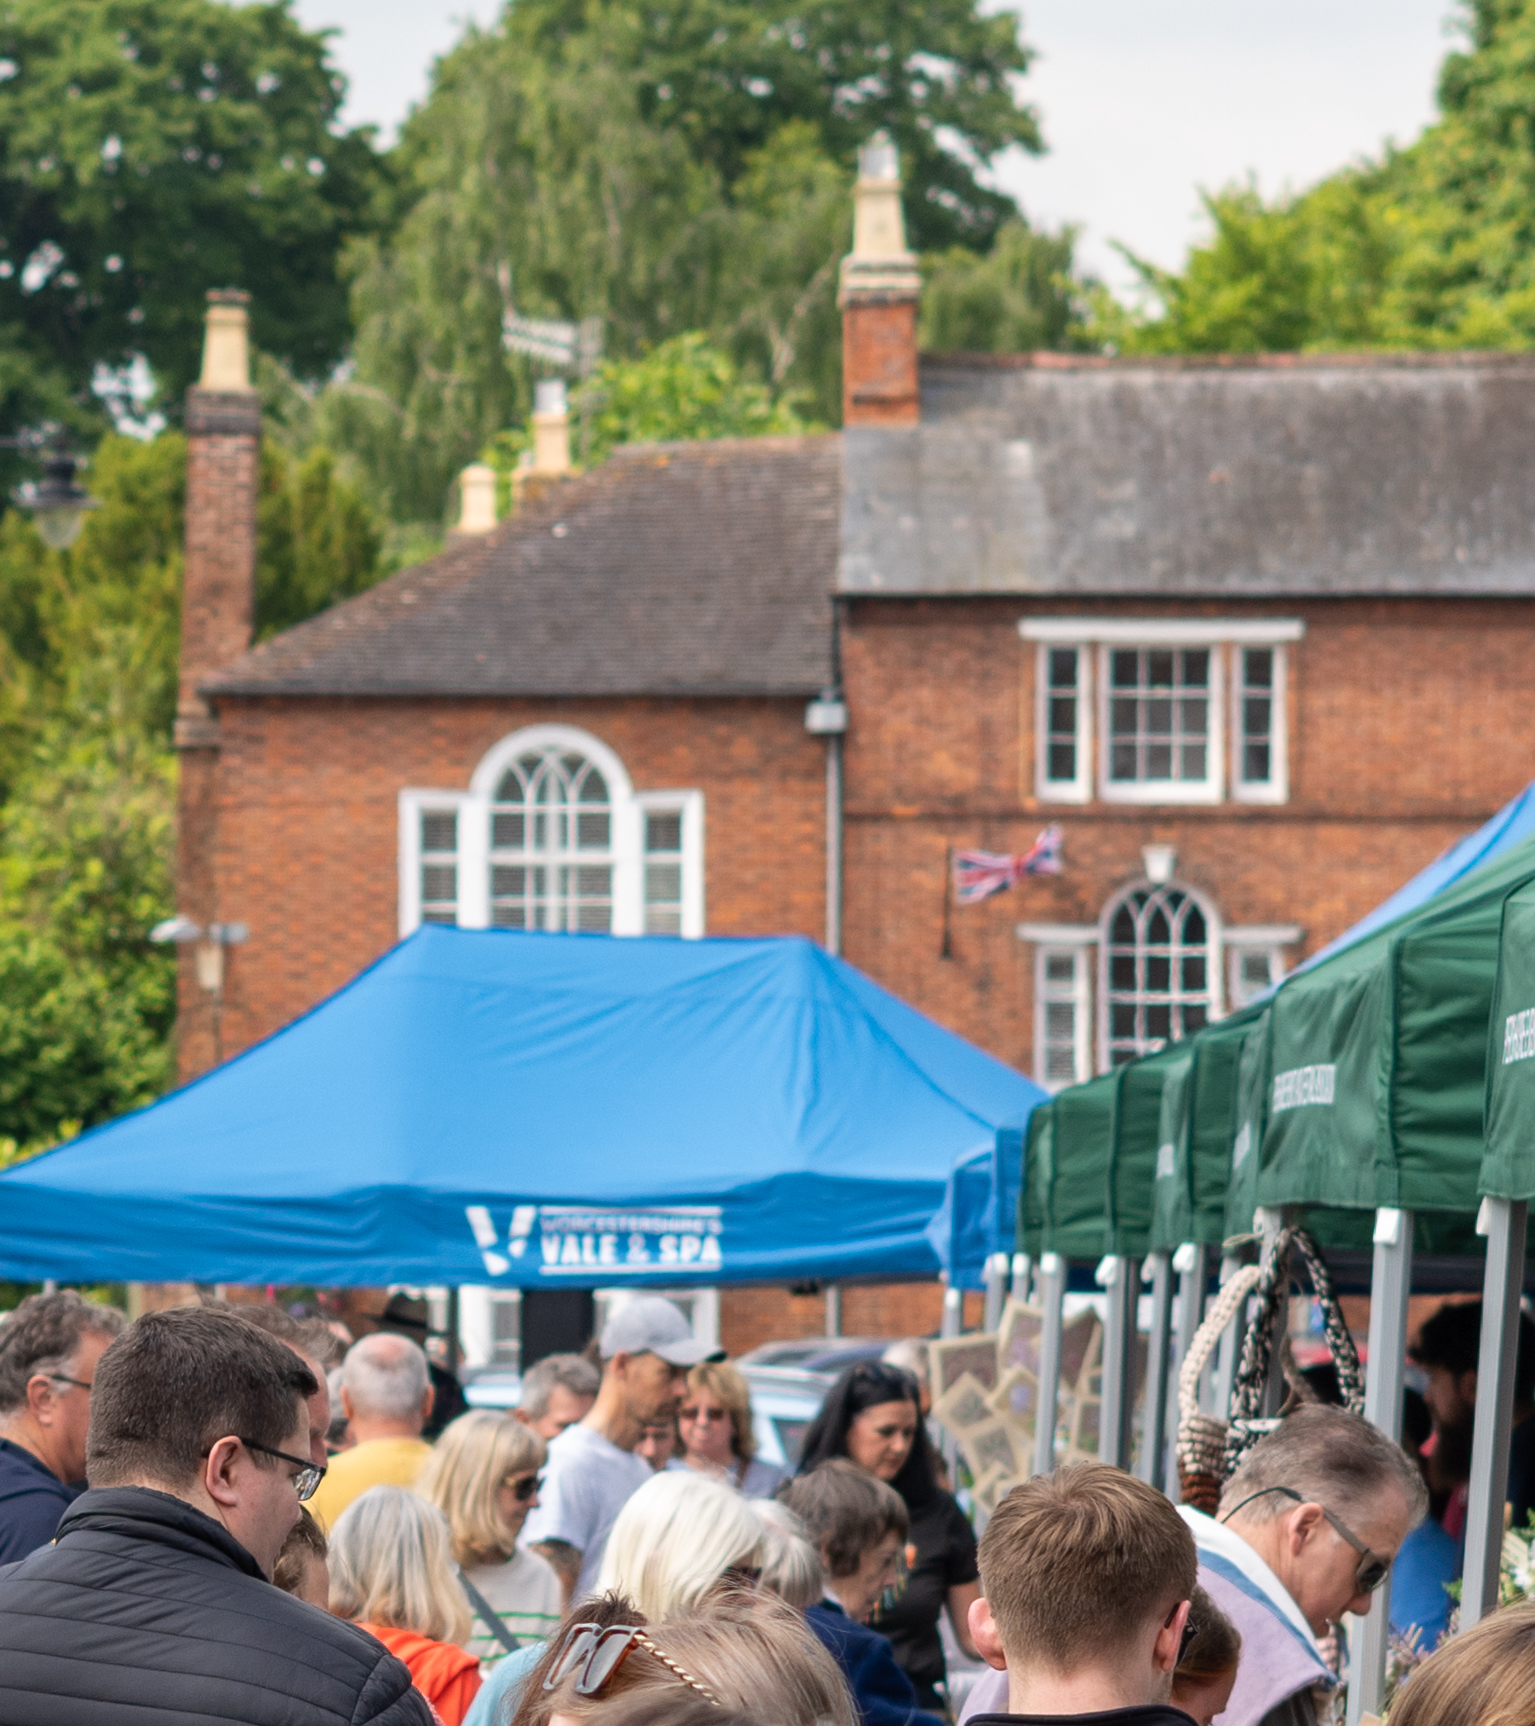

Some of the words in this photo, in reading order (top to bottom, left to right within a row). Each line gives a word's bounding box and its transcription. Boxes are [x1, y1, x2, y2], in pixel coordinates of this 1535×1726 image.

[541, 1234, 618, 1265] VALE
[627, 1233, 650, 1263] &
[658, 1233, 722, 1264] SPA
